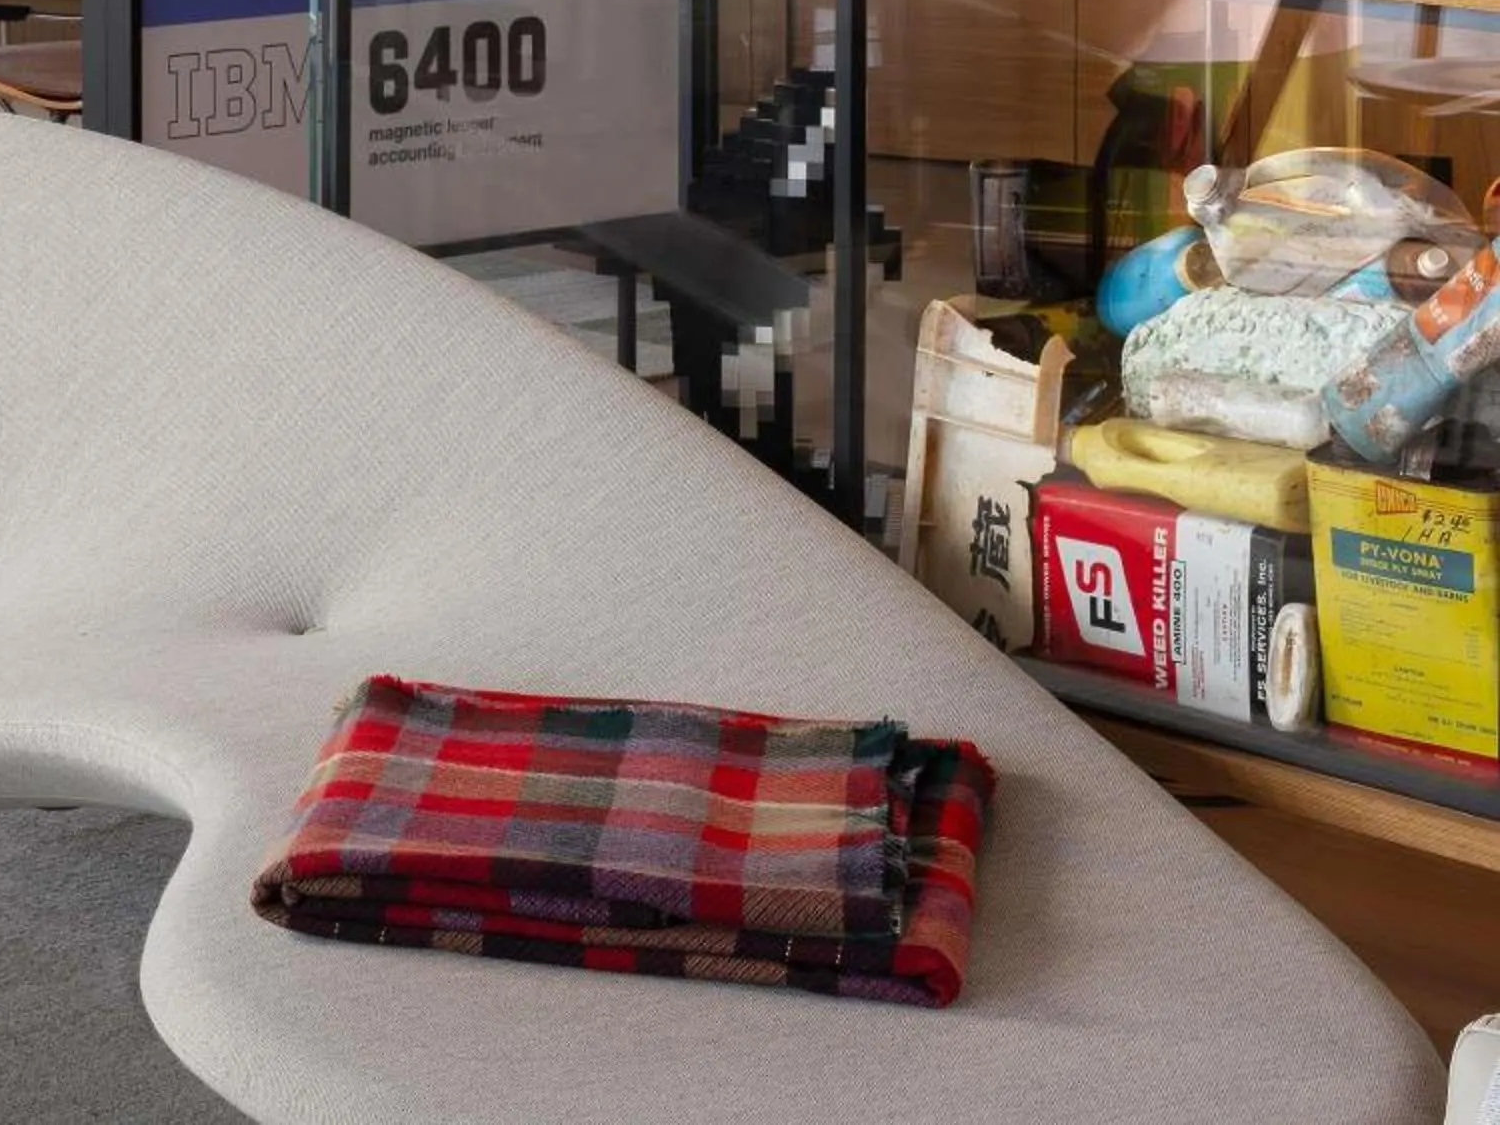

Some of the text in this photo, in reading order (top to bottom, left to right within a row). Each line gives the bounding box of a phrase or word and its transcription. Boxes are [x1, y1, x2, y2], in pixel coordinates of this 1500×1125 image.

[167, 34, 324, 140] IBM
[369, 16, 546, 115] 6400
[368, 121, 443, 144] magnetic
[446, 116, 496, 134] leer
[368, 142, 456, 166] accounting
[1257, 559, 1268, 586] Inc.
[1360, 541, 1441, 569] PY-VONA
[1075, 558, 1126, 634] FS
[1152, 526, 1169, 690] WEED KILLER
[1173, 568, 1183, 655] AMINE 400
